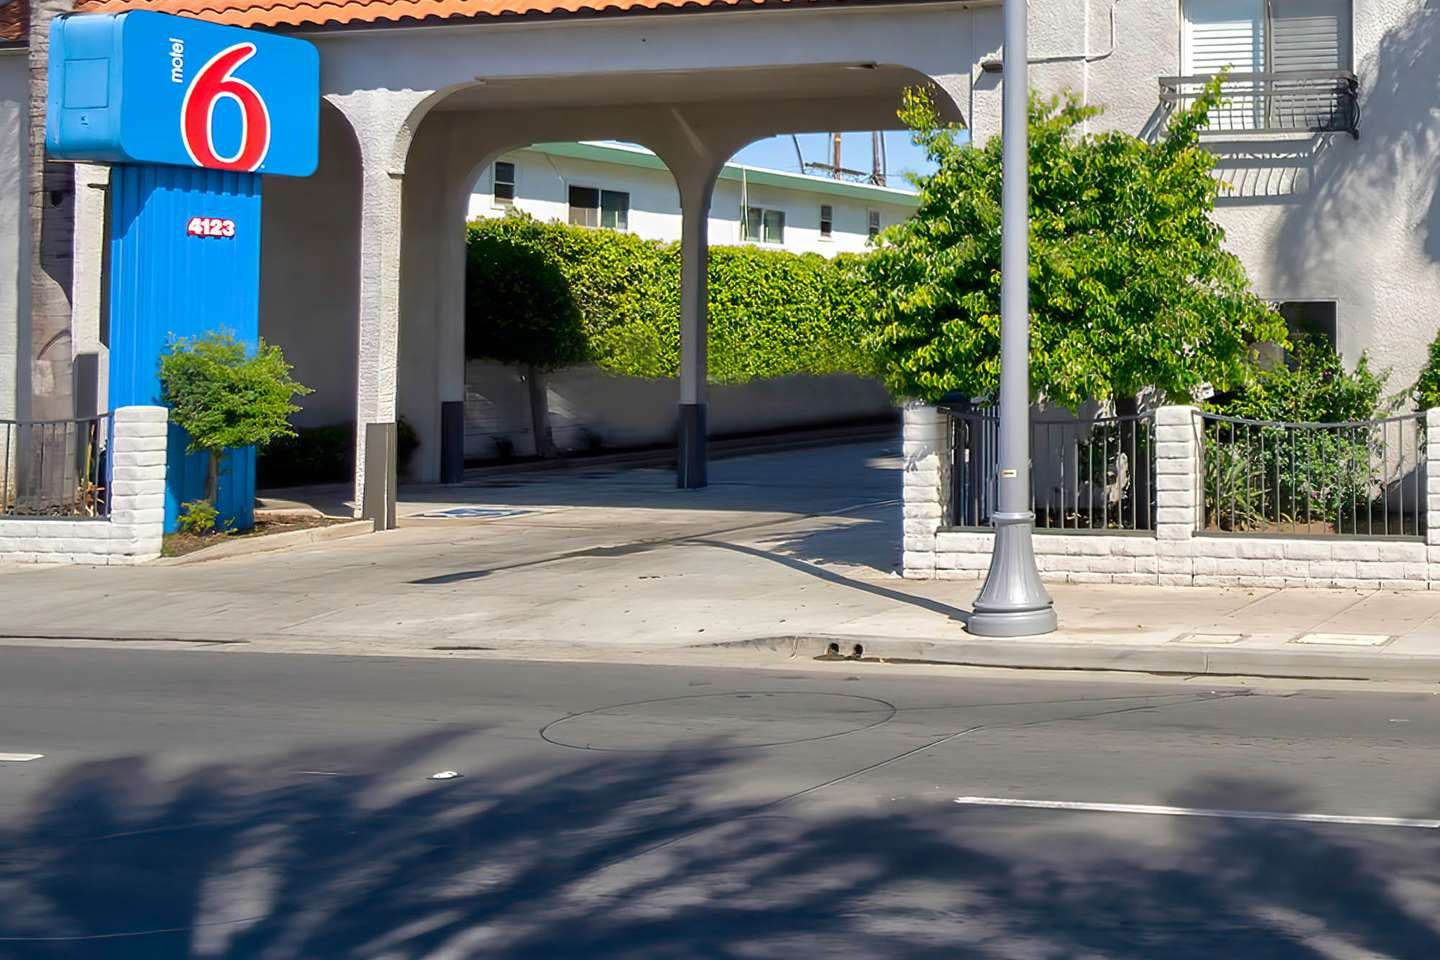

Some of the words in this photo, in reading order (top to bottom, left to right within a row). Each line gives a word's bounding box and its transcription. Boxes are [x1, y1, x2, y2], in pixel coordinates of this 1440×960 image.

[169, 37, 185, 83] motel
[180, 41, 271, 172] 6
[188, 217, 236, 237] 4123
